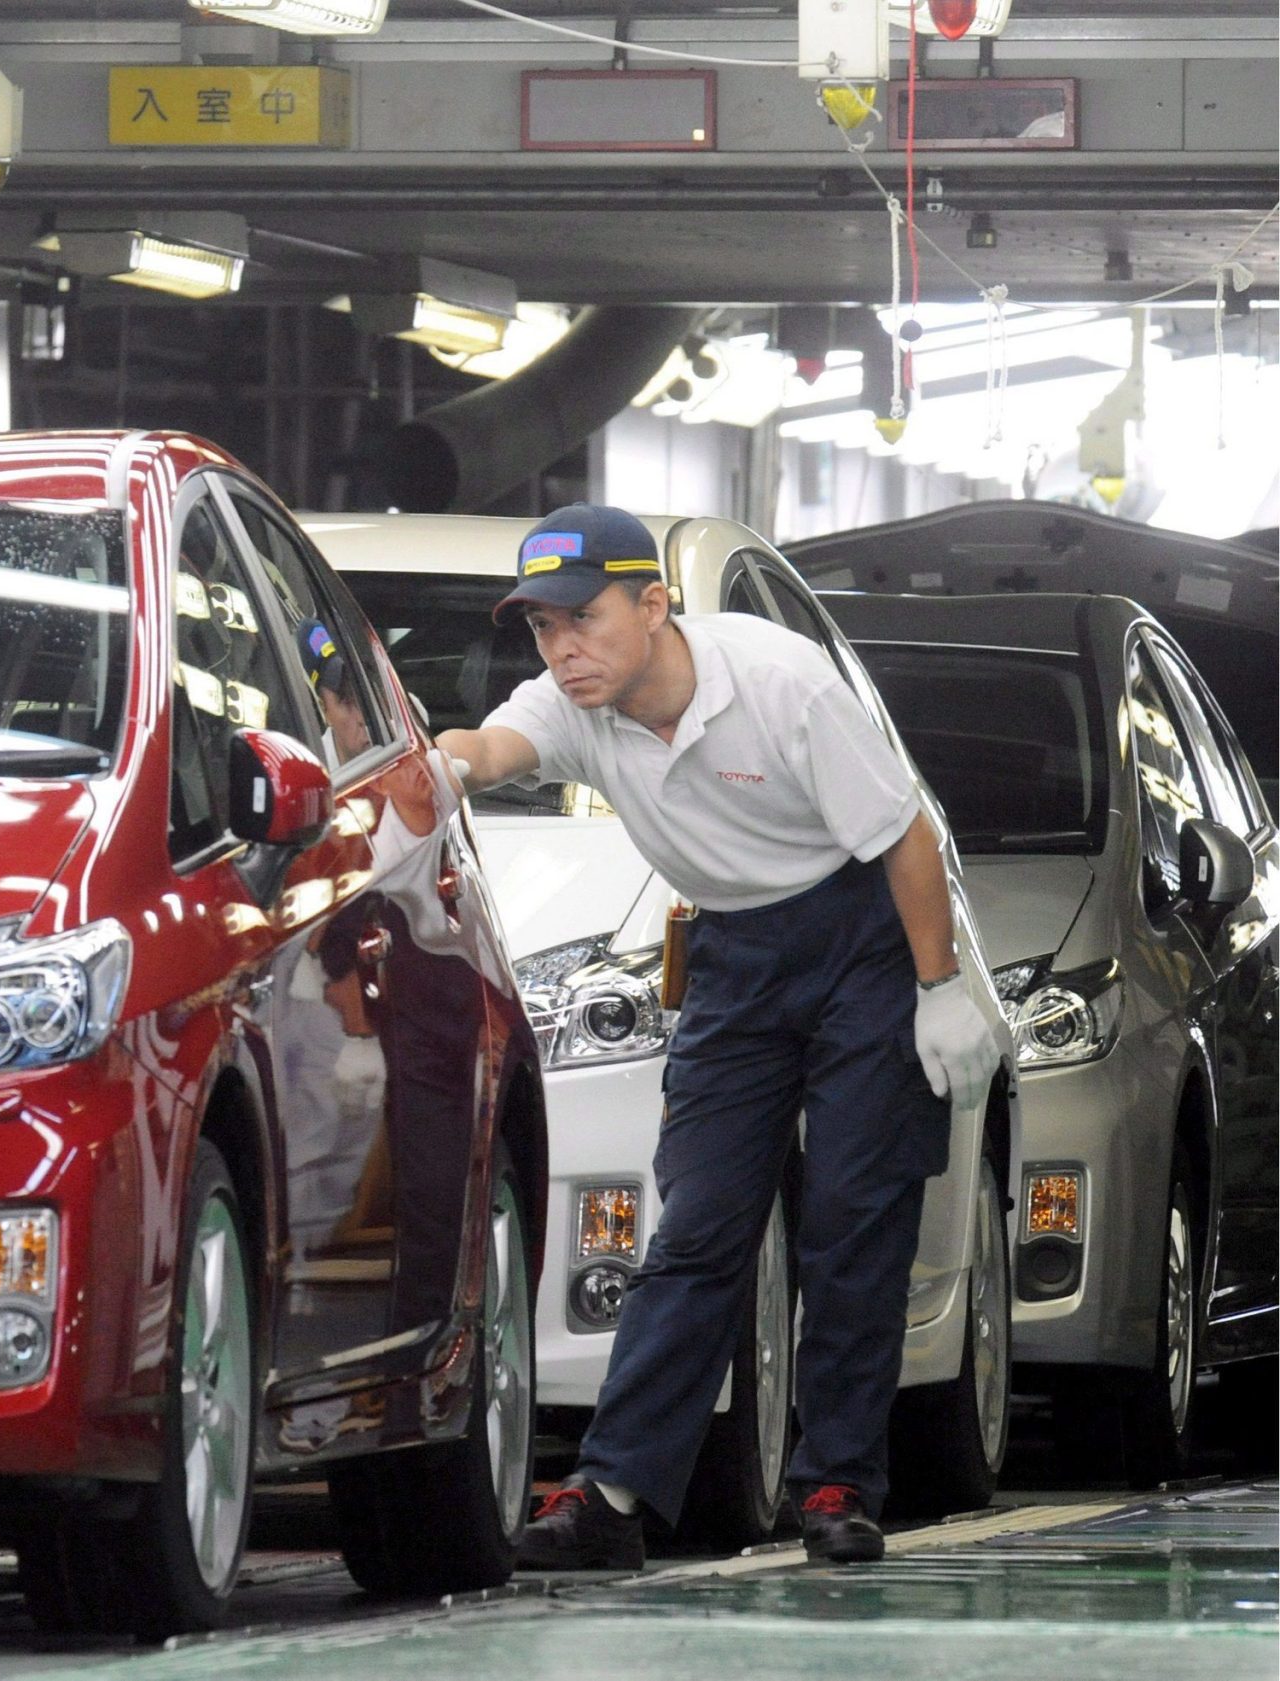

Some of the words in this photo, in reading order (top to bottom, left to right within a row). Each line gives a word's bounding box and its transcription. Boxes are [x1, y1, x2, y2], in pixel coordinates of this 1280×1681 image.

[131, 87, 295, 125] 入室中
[716, 770, 766, 784] TOYOTA
